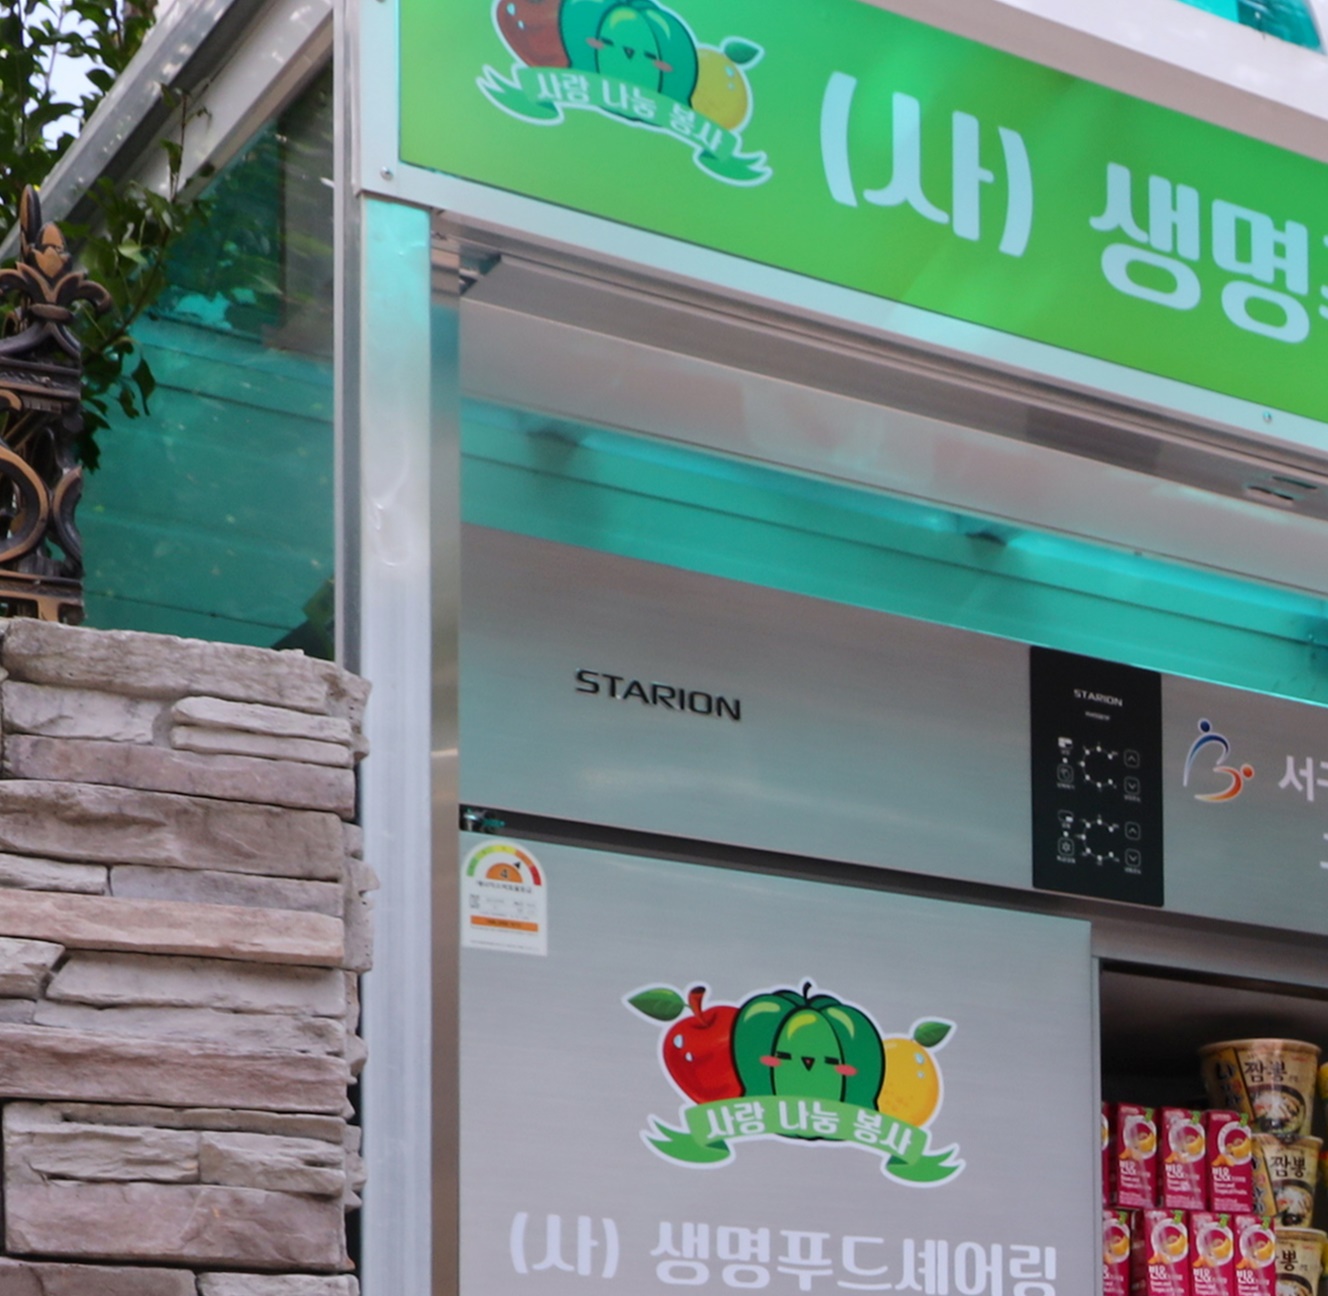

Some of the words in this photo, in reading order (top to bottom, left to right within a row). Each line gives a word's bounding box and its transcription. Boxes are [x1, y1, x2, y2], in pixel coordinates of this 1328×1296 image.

[537, 72, 590, 104] 사랑
[602, 79, 657, 119] 나눔
[669, 103, 723, 152] 봉사
[819, 70, 1034, 257] (사)
[574, 669, 742, 721] STARION
[1073, 688, 1123, 707] STARION
[707, 1102, 766, 1139] 사랑
[778, 1100, 840, 1135] 나눔
[853, 1110, 912, 1155] 봉사
[509, 1211, 621, 1279] (사)
